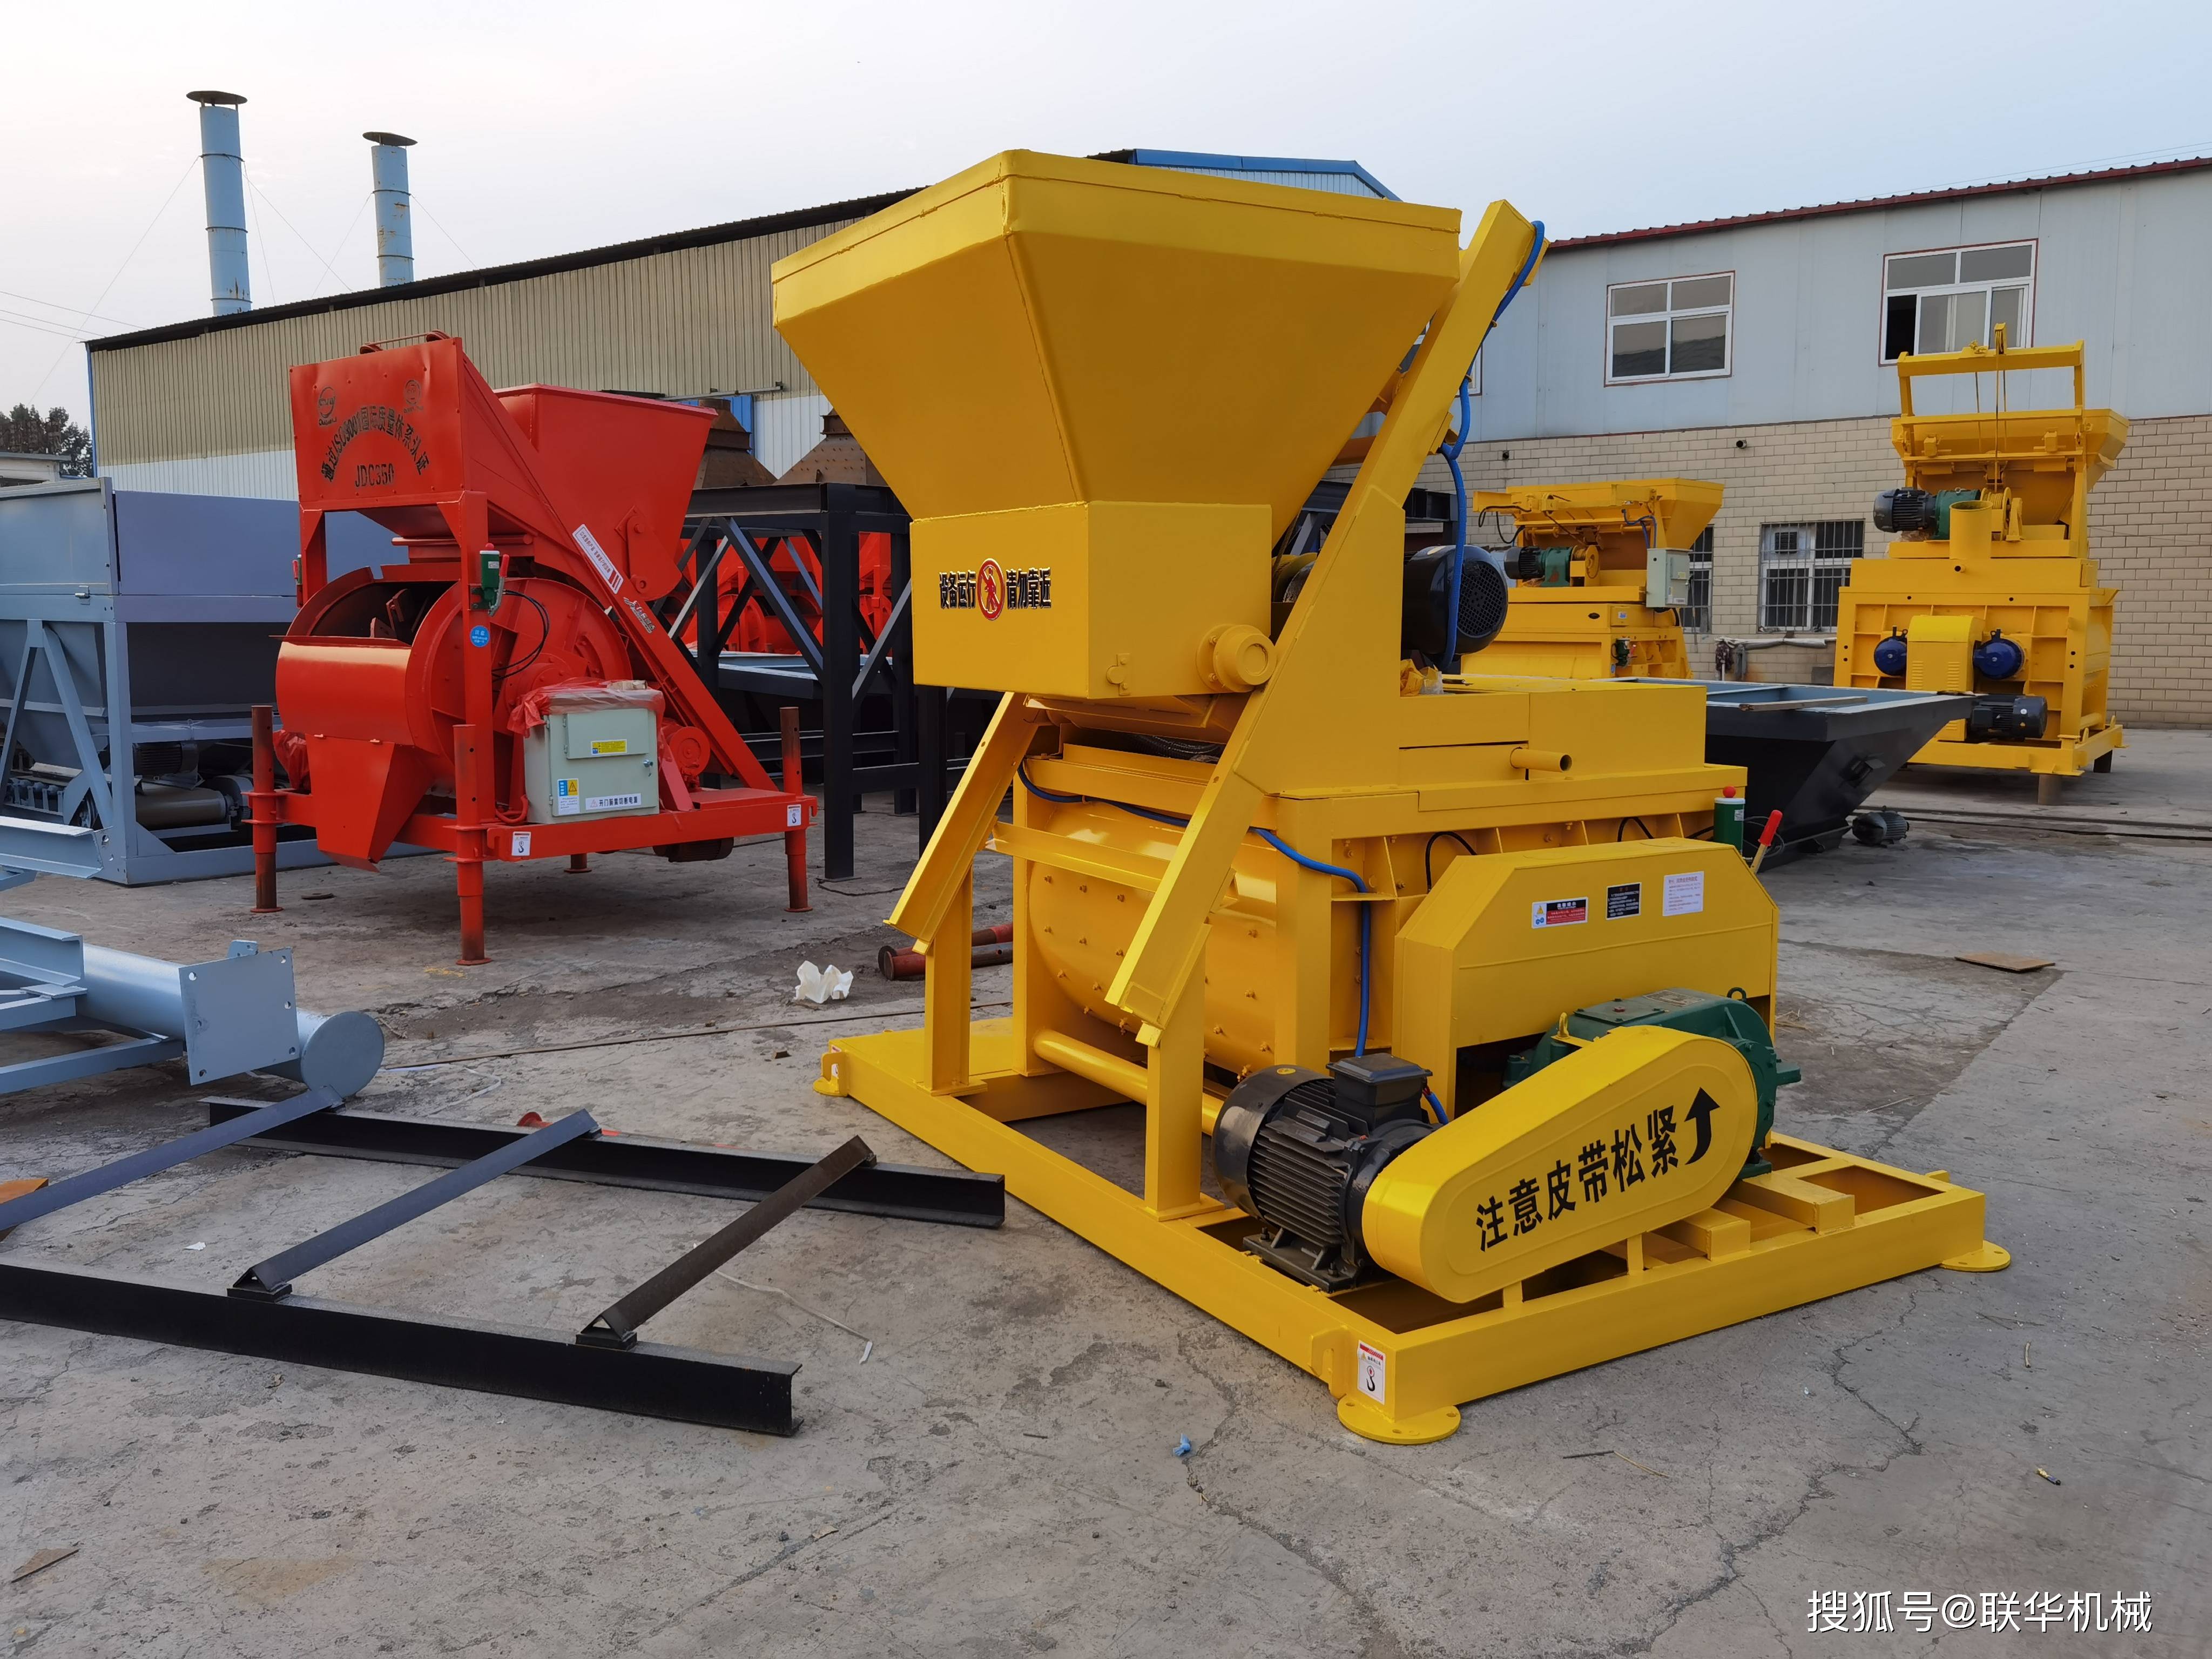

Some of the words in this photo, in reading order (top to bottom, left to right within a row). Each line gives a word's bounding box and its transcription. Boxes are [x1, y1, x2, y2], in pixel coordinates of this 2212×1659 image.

[1476, 1105, 1678, 1252] 注意皮带松紧
